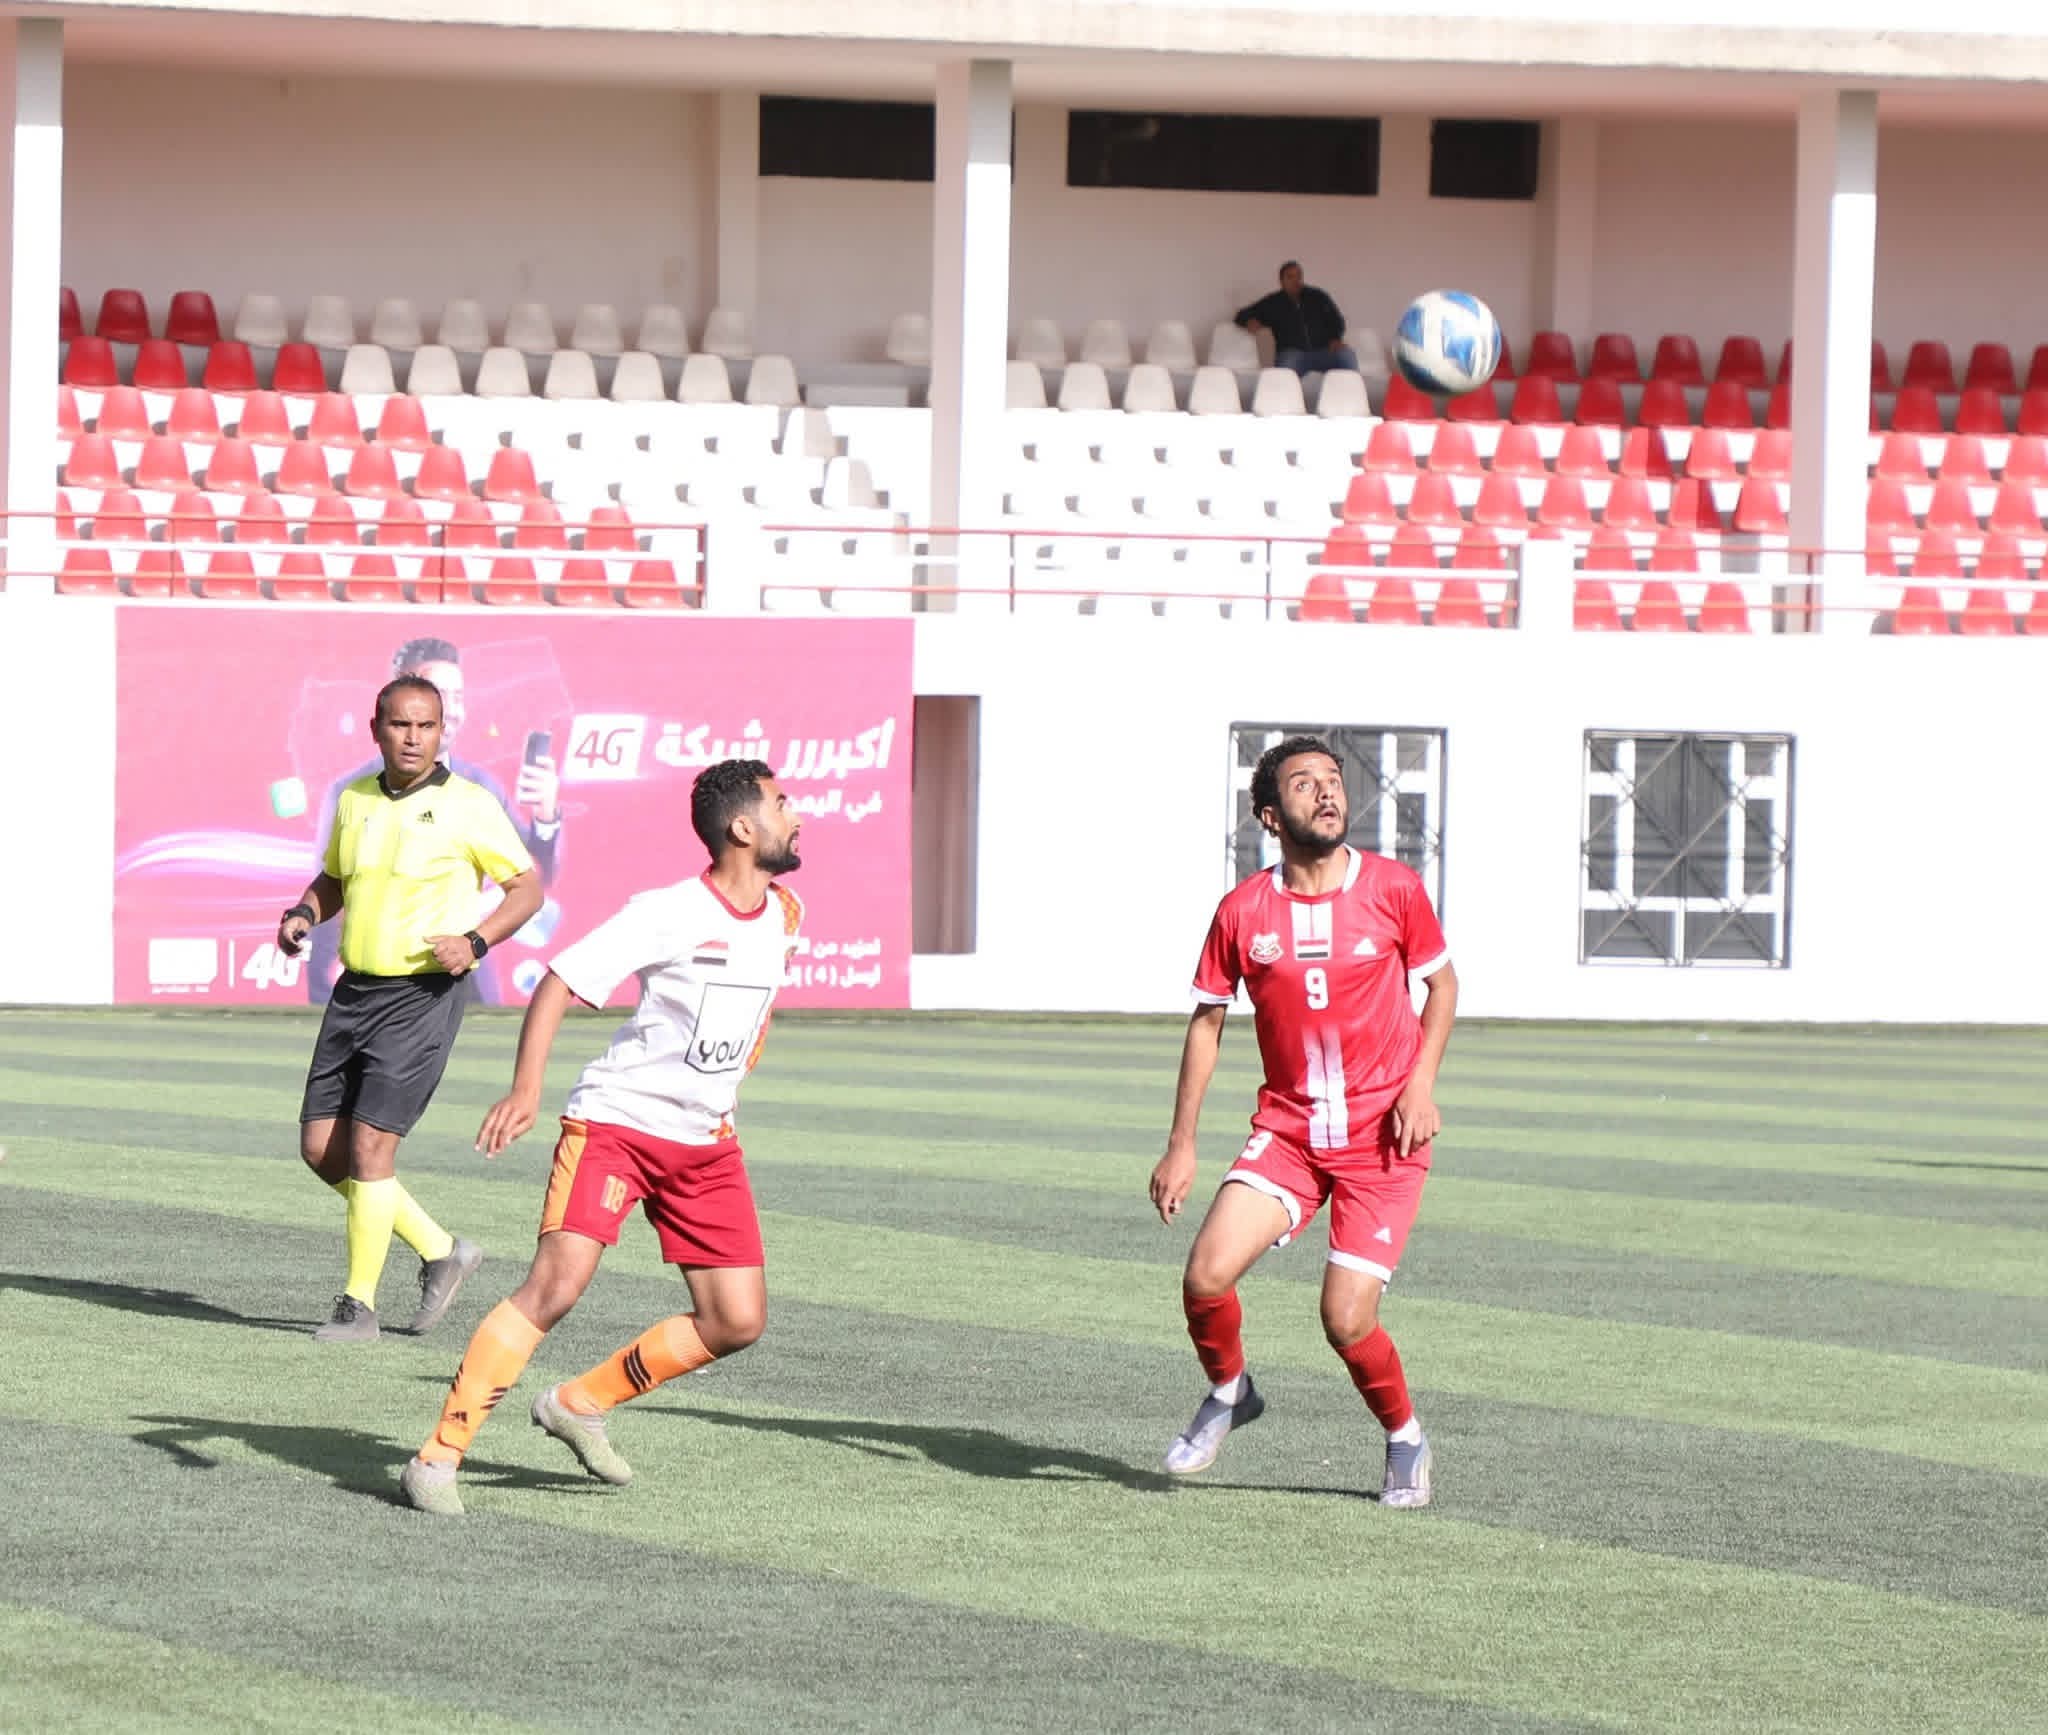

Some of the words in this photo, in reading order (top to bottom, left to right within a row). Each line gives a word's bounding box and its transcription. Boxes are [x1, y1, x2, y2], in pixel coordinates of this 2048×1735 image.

[575, 728, 636, 769] 4G
[655, 719, 771, 768] شبكة
[786, 789, 842, 818] اليم
[845, 790, 882, 823] في
[1304, 967, 1329, 1010] 9
[698, 1039, 745, 1065] YOU
[600, 1174, 628, 1215] 18
